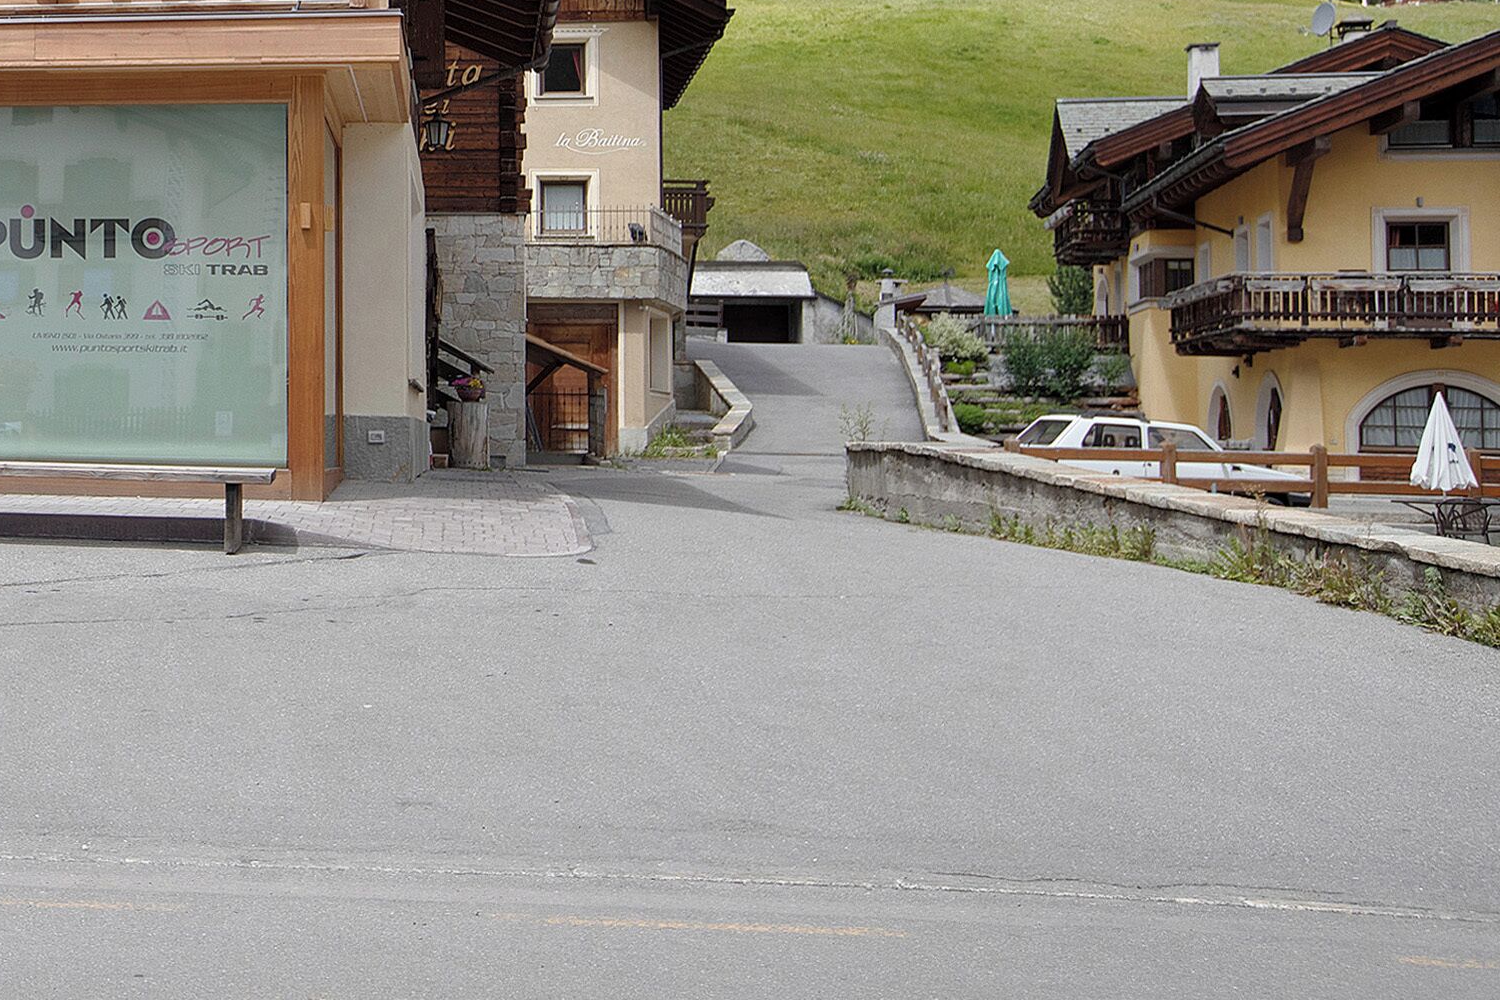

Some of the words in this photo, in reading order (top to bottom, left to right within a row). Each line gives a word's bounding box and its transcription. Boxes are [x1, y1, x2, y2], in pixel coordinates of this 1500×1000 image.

[555, 132, 571, 147] la
[163, 234, 271, 259] SPORT
[163, 263, 200, 276] SKI
[206, 263, 269, 276] TRAB
